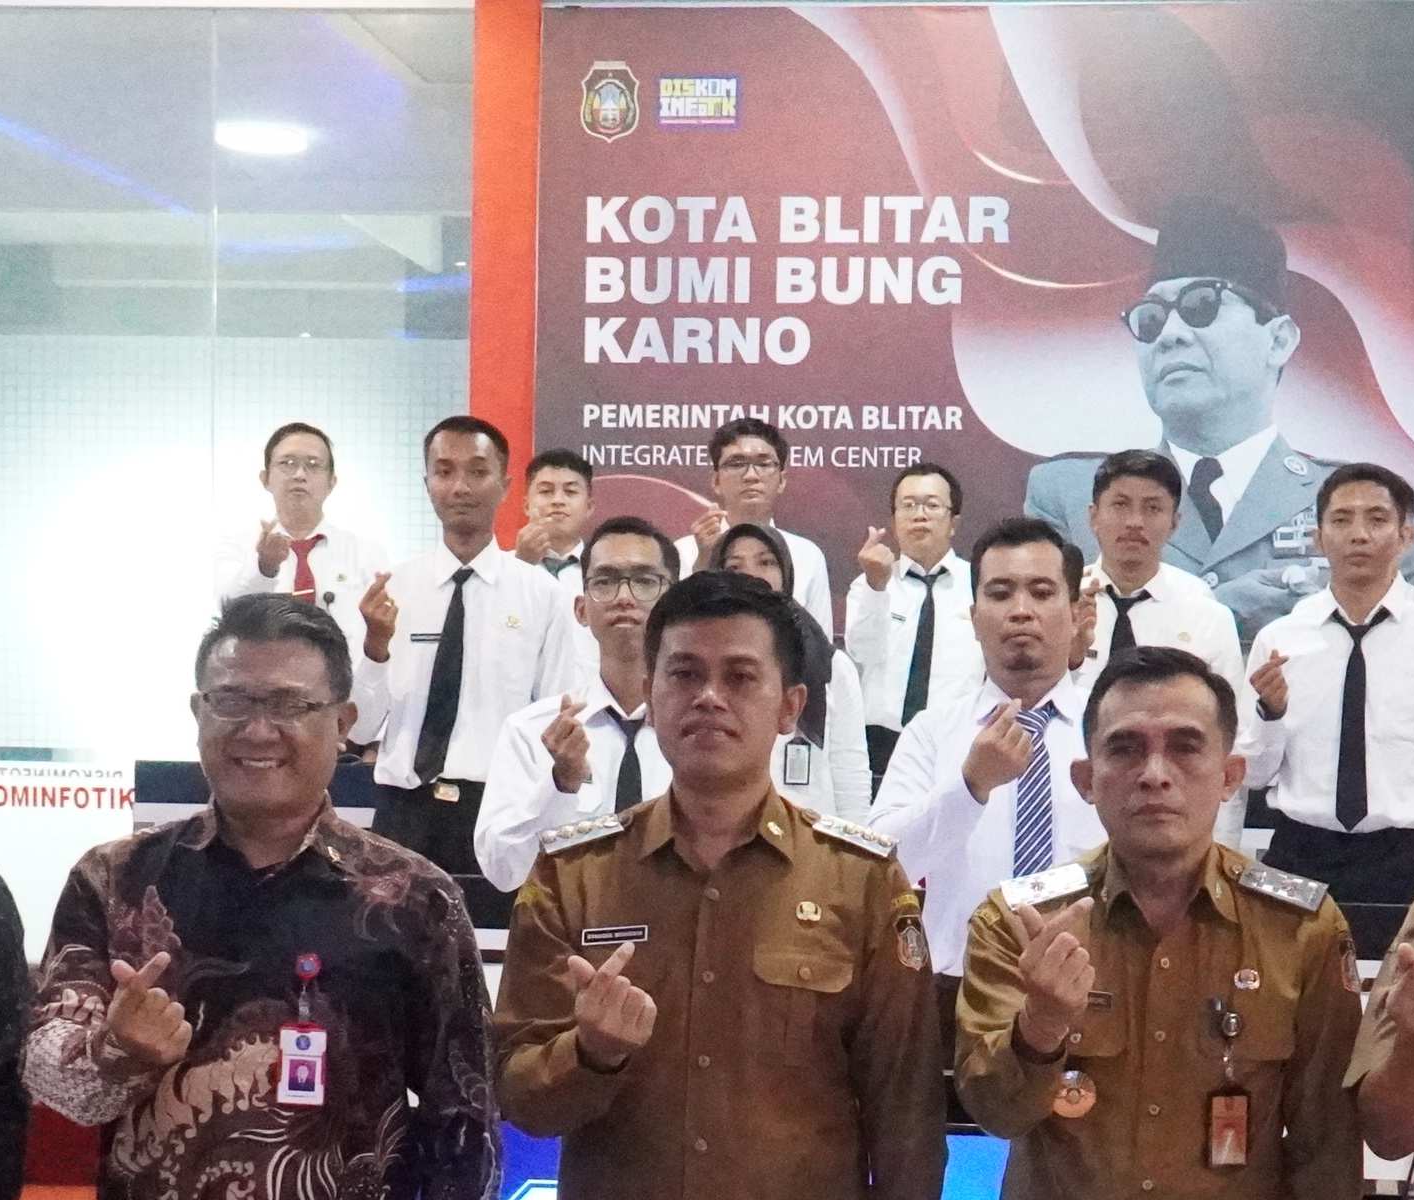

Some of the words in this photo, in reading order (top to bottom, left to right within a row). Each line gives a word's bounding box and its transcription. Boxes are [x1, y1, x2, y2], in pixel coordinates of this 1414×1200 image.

[660, 79, 736, 96] DISKOM
[585, 195, 758, 244] KOTA
[780, 195, 1010, 244] BLITAR
[585, 256, 751, 305] BUMI
[776, 255, 962, 305] BUNG
[584, 316, 811, 366] KARNO
[583, 403, 770, 429] PEMERINTAH
[778, 404, 854, 430] KOTA
[862, 404, 964, 431] BLITAR
[582, 444, 713, 467] INTEGRATE
[790, 445, 824, 467] EM
[830, 446, 922, 468] CENTER
